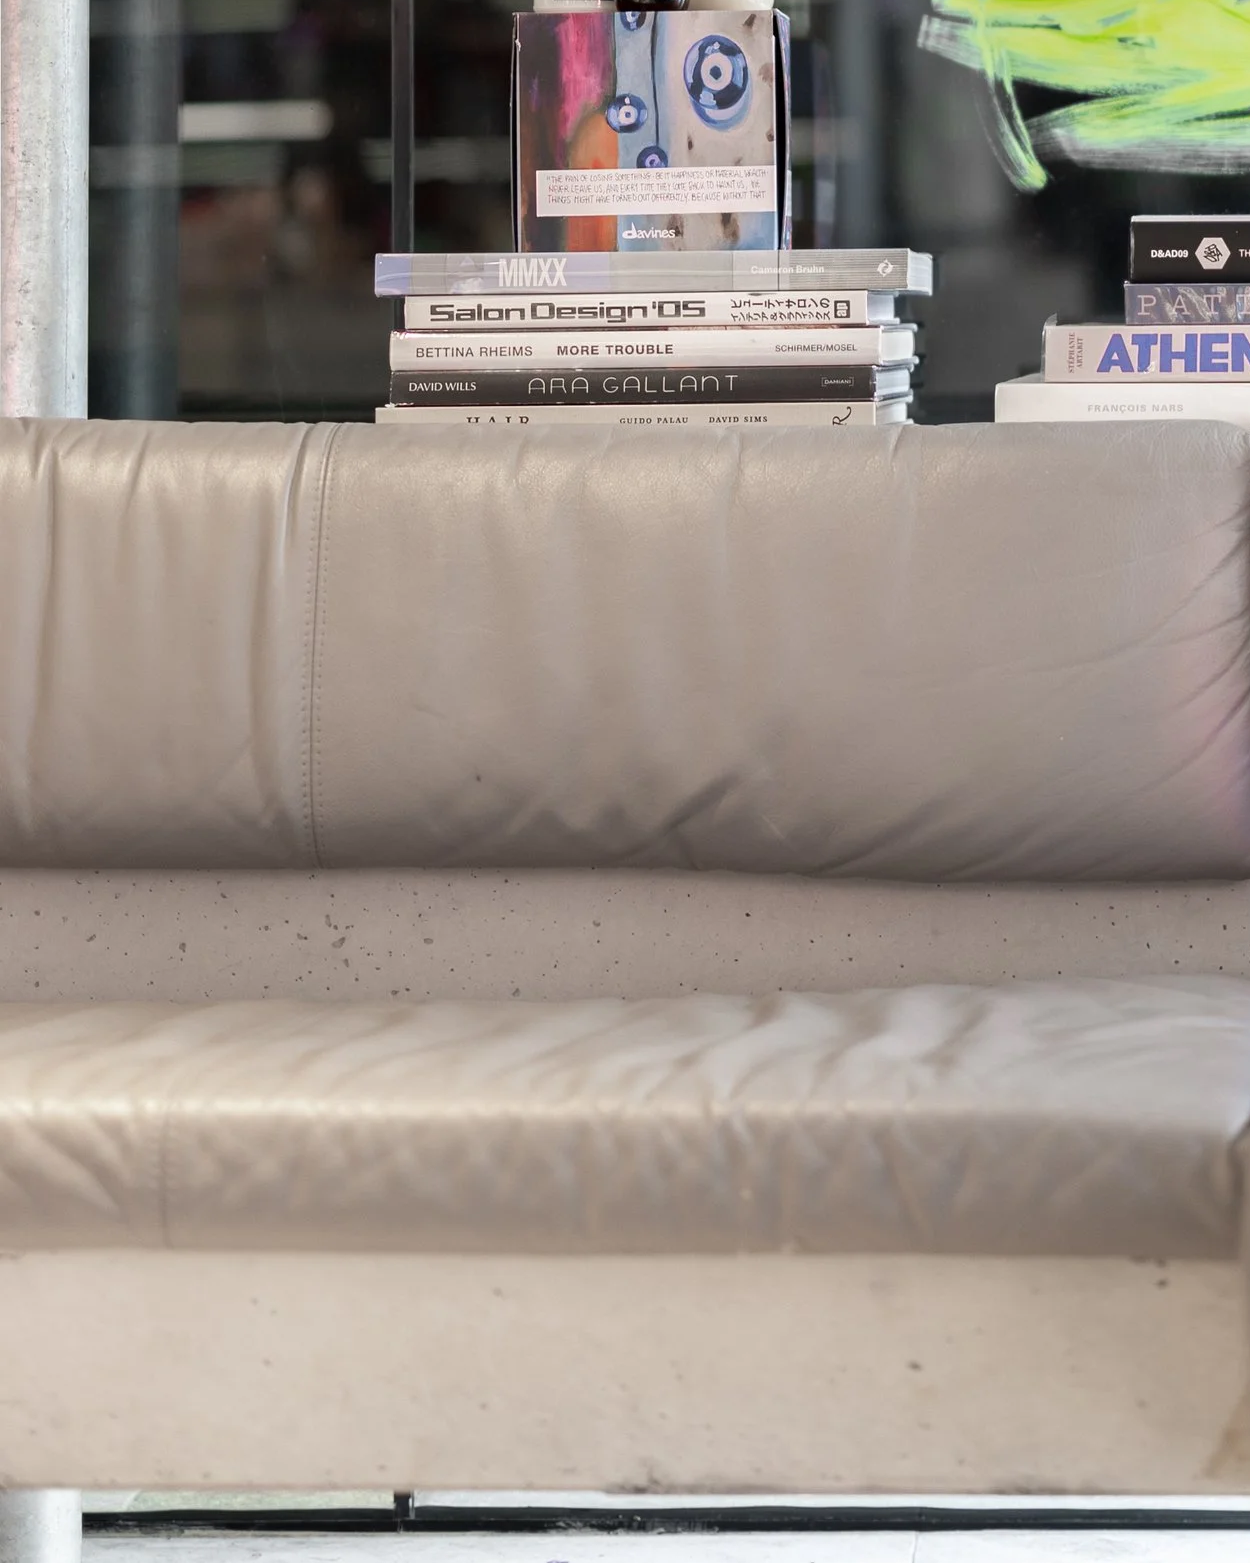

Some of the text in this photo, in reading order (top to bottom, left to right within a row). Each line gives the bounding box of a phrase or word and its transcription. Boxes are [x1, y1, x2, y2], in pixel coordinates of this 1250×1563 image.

[671, 170, 704, 179] HAPPINESS
[657, 182, 671, 192] THEY
[706, 180, 714, 189] TO
[548, 194, 571, 204] THINGS
[691, 191, 721, 202] BECAUSE
[750, 190, 767, 199] THAT
[622, 222, 676, 239] davines
[1150, 248, 1189, 258] D&AD09
[498, 258, 567, 287] MMXX
[750, 264, 825, 275] Cameron Bruhn
[430, 303, 526, 322] Salon
[530, 302, 648, 324] Design
[416, 345, 533, 358] BETTINA RHEIMS
[556, 344, 674, 356] MORE TROUBLE
[775, 343, 858, 353] SCHIRMER/MOSEL
[408, 381, 477, 392] DAVID WILLS
[528, 374, 739, 395] ARA GALLANT
[1087, 404, 1184, 414] FRANÇOIS NARS
[619, 415, 768, 425] GUIDO PALAU DAVID SIMS
